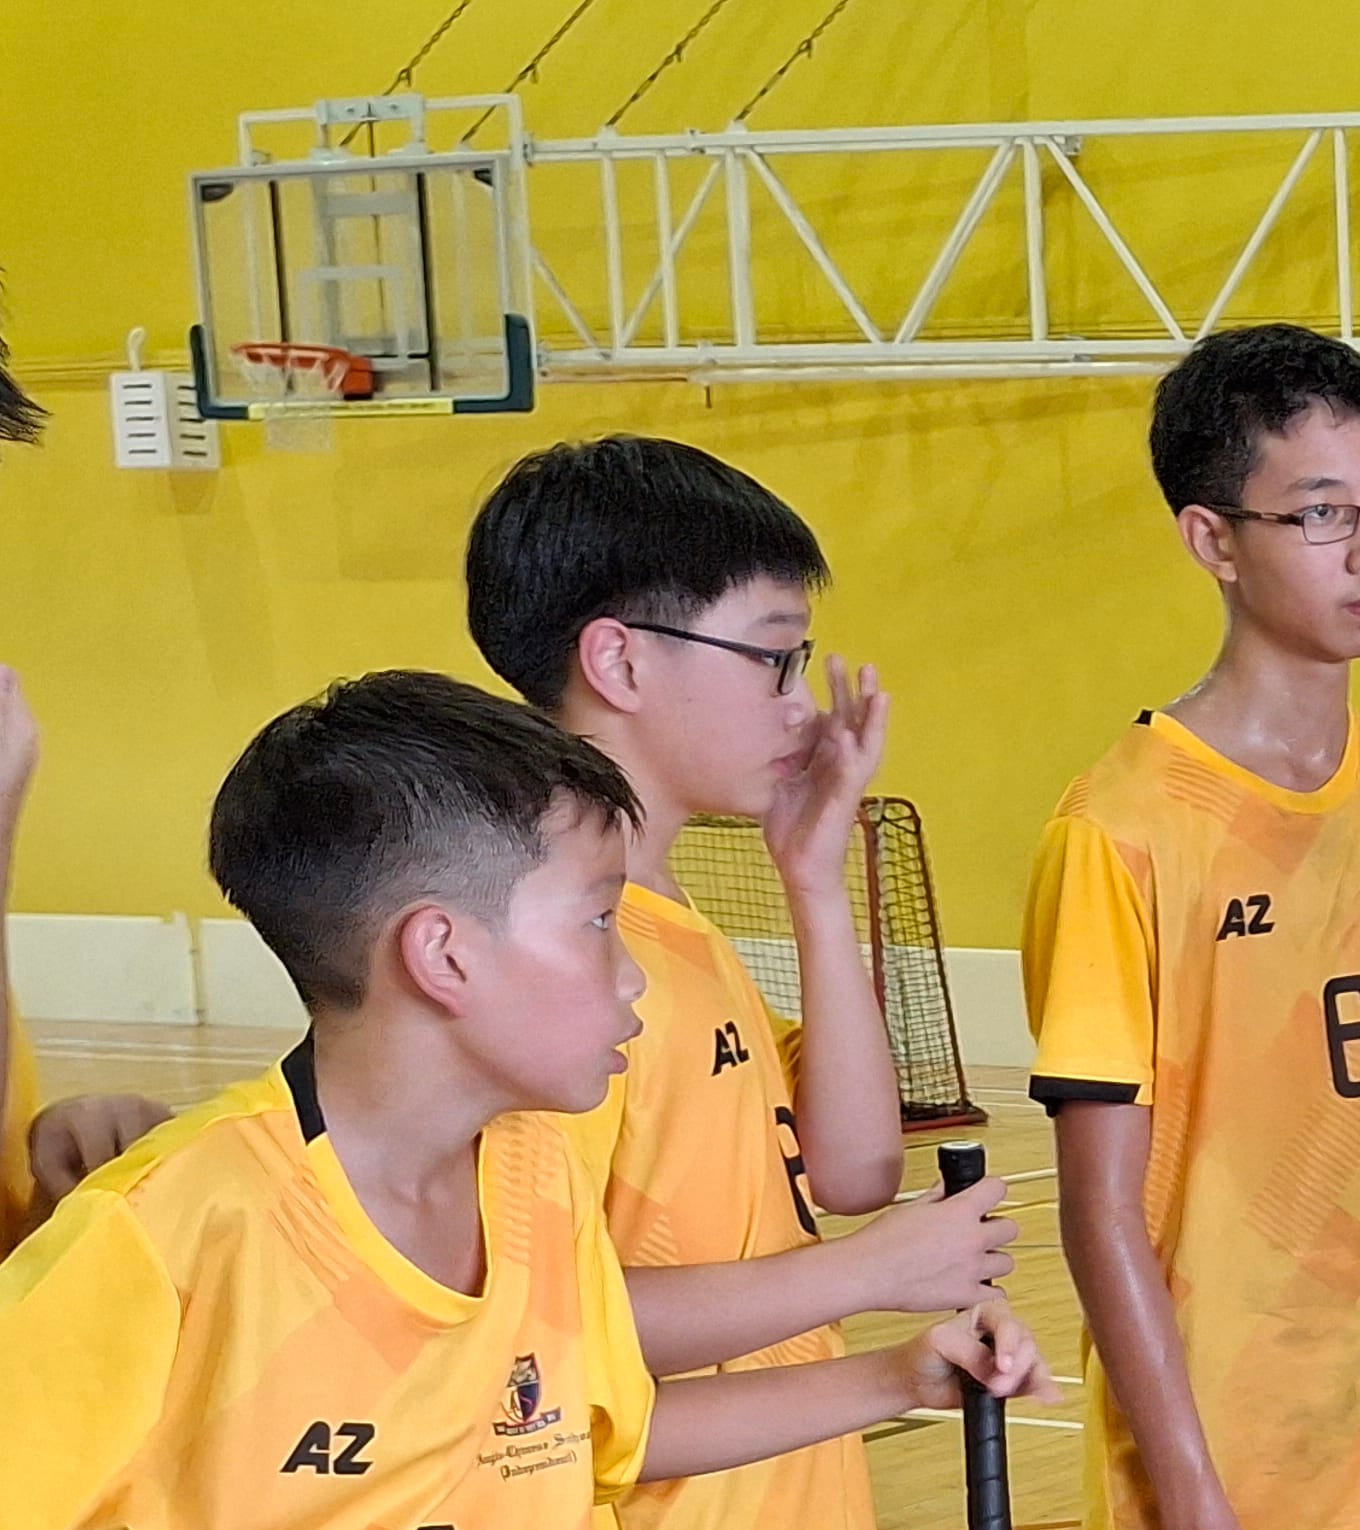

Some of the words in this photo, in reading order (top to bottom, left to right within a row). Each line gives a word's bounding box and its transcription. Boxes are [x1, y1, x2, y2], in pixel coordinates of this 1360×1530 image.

[1215, 894, 1276, 941] AZ
[711, 1021, 750, 1077] AZ
[280, 1420, 375, 1475] AZ
